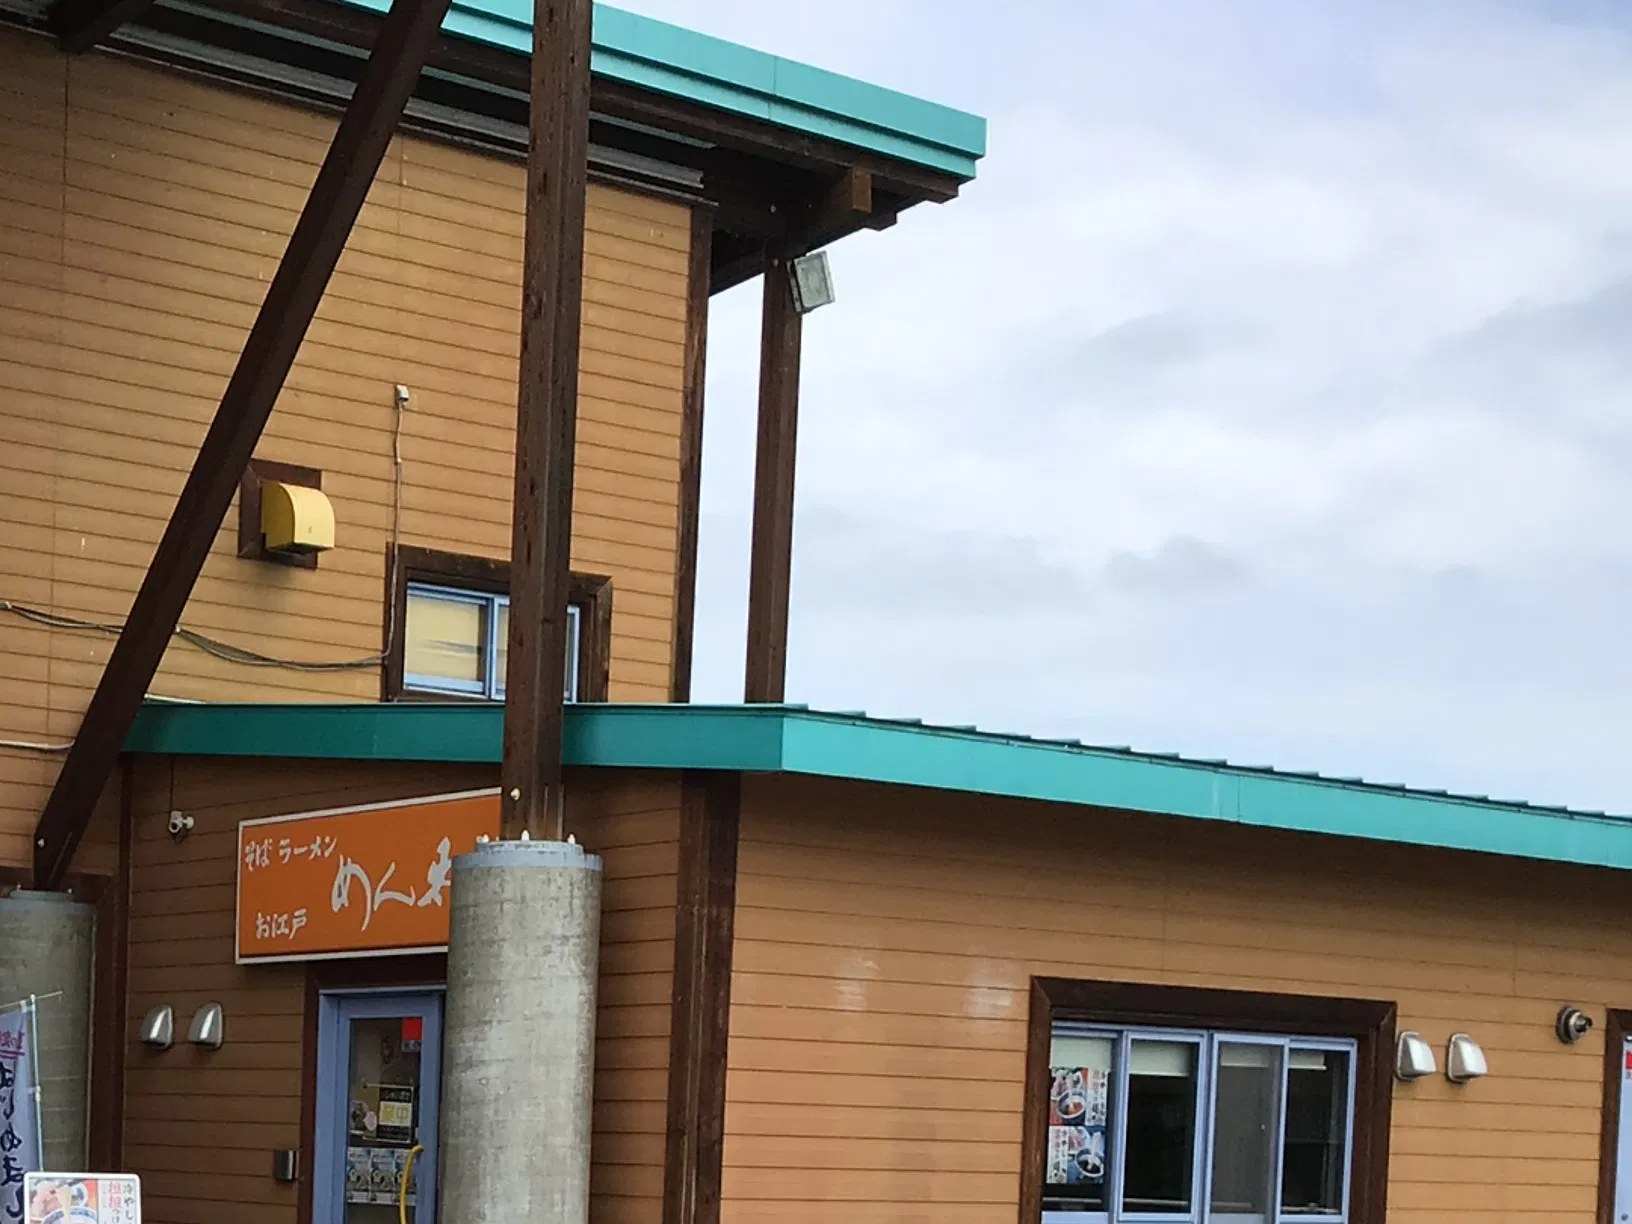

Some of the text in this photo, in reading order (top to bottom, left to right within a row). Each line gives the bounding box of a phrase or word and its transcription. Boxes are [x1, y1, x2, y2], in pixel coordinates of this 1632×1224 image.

[278, 835, 338, 864] ラーメン
[255, 907, 308, 941] お江戸
